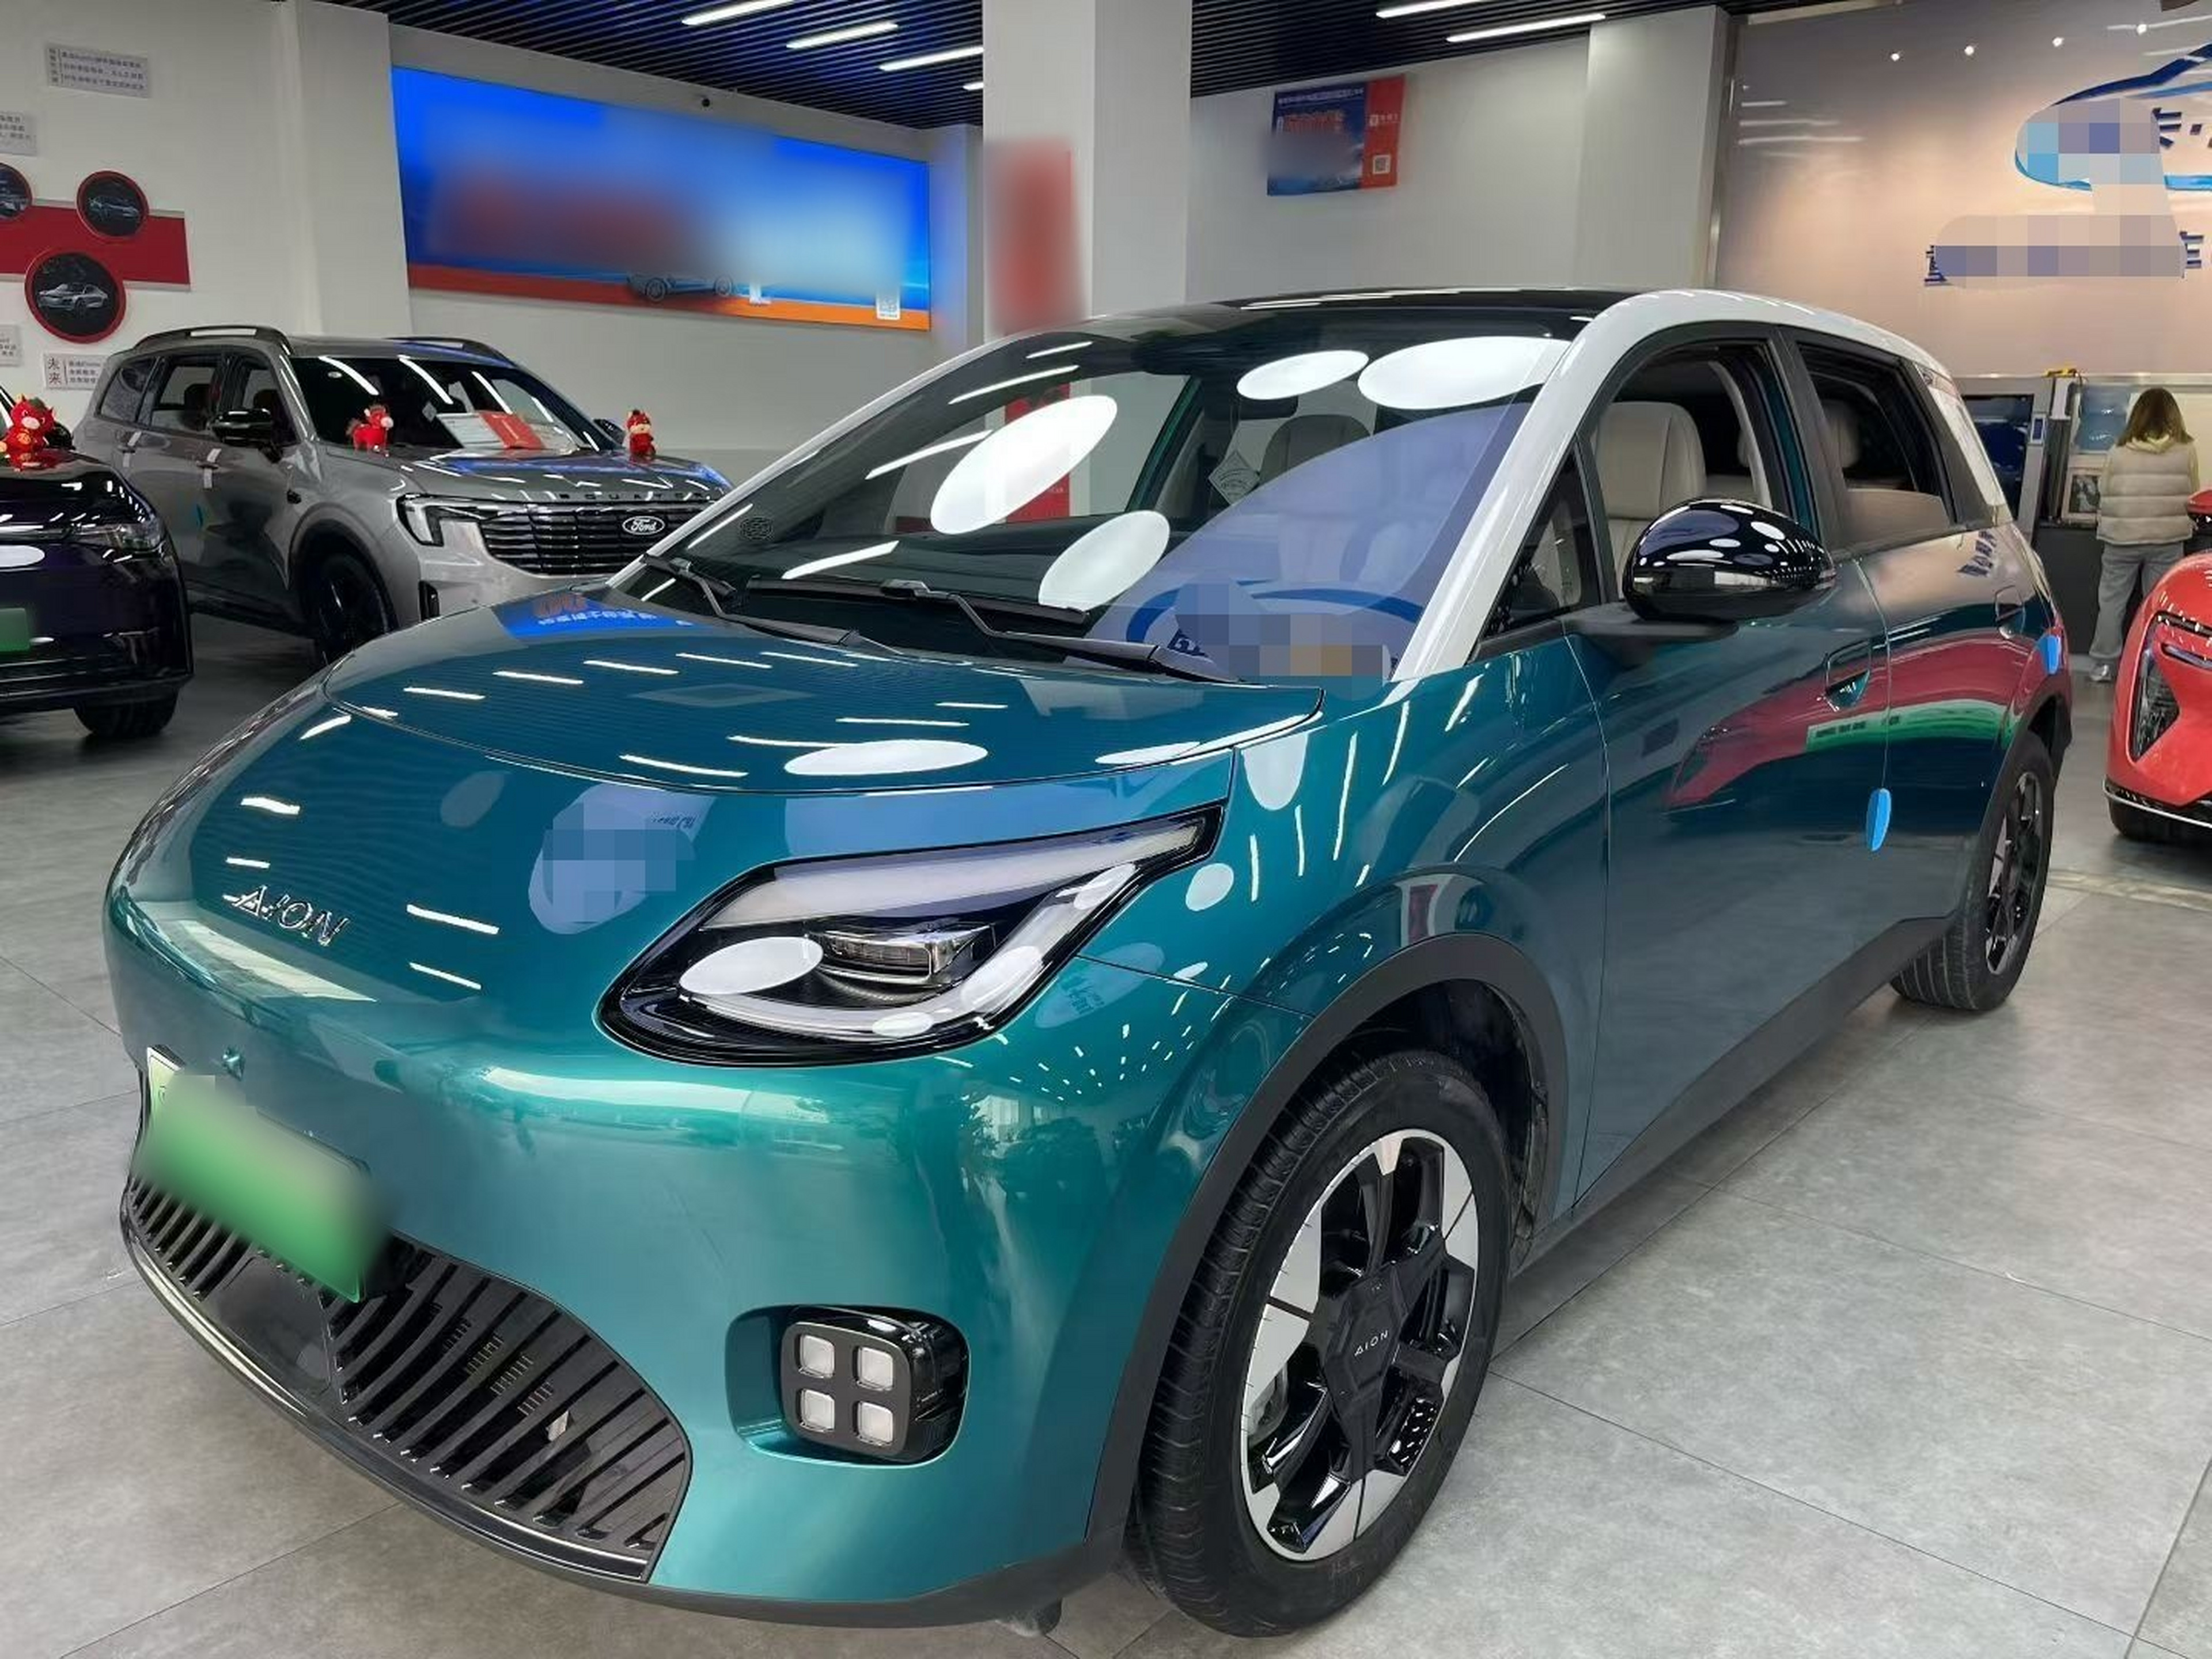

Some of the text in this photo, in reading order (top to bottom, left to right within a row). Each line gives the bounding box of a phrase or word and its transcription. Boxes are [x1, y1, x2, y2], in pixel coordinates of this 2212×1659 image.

[630, 519, 657, 532] Ford
[222, 885, 351, 946] AION
[1354, 1330, 1388, 1357] AION
